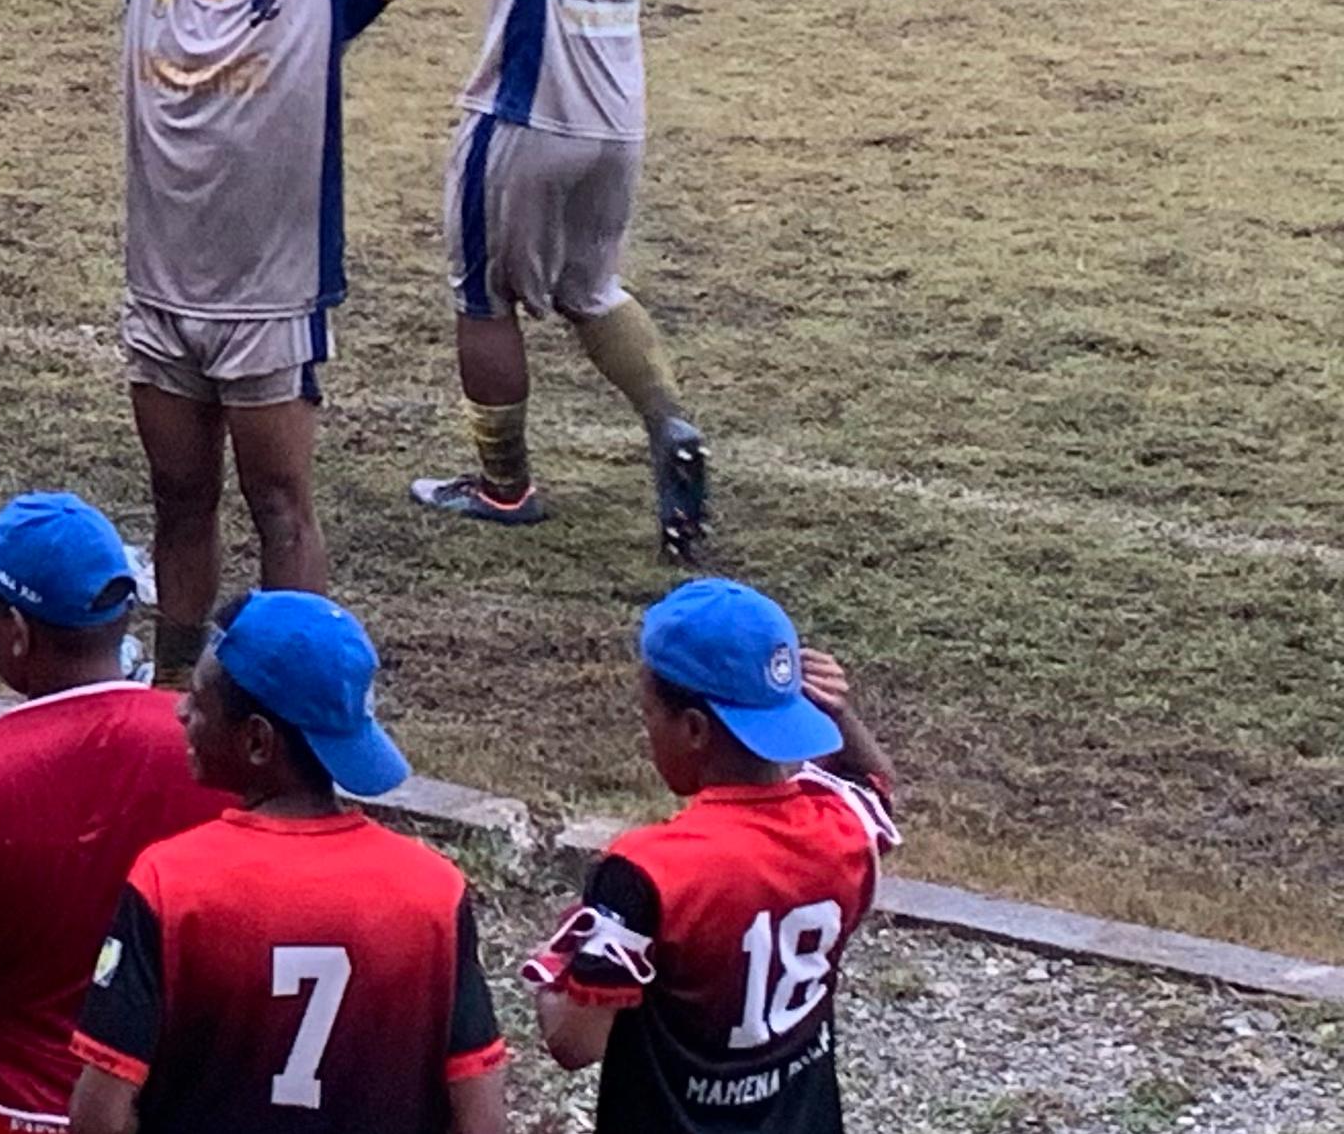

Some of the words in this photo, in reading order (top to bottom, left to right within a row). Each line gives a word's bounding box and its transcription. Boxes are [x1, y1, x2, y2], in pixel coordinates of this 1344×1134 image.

[270, 945, 353, 1110] 7
[727, 898, 842, 1049] 18
[686, 1067, 781, 1106] MAMENA
